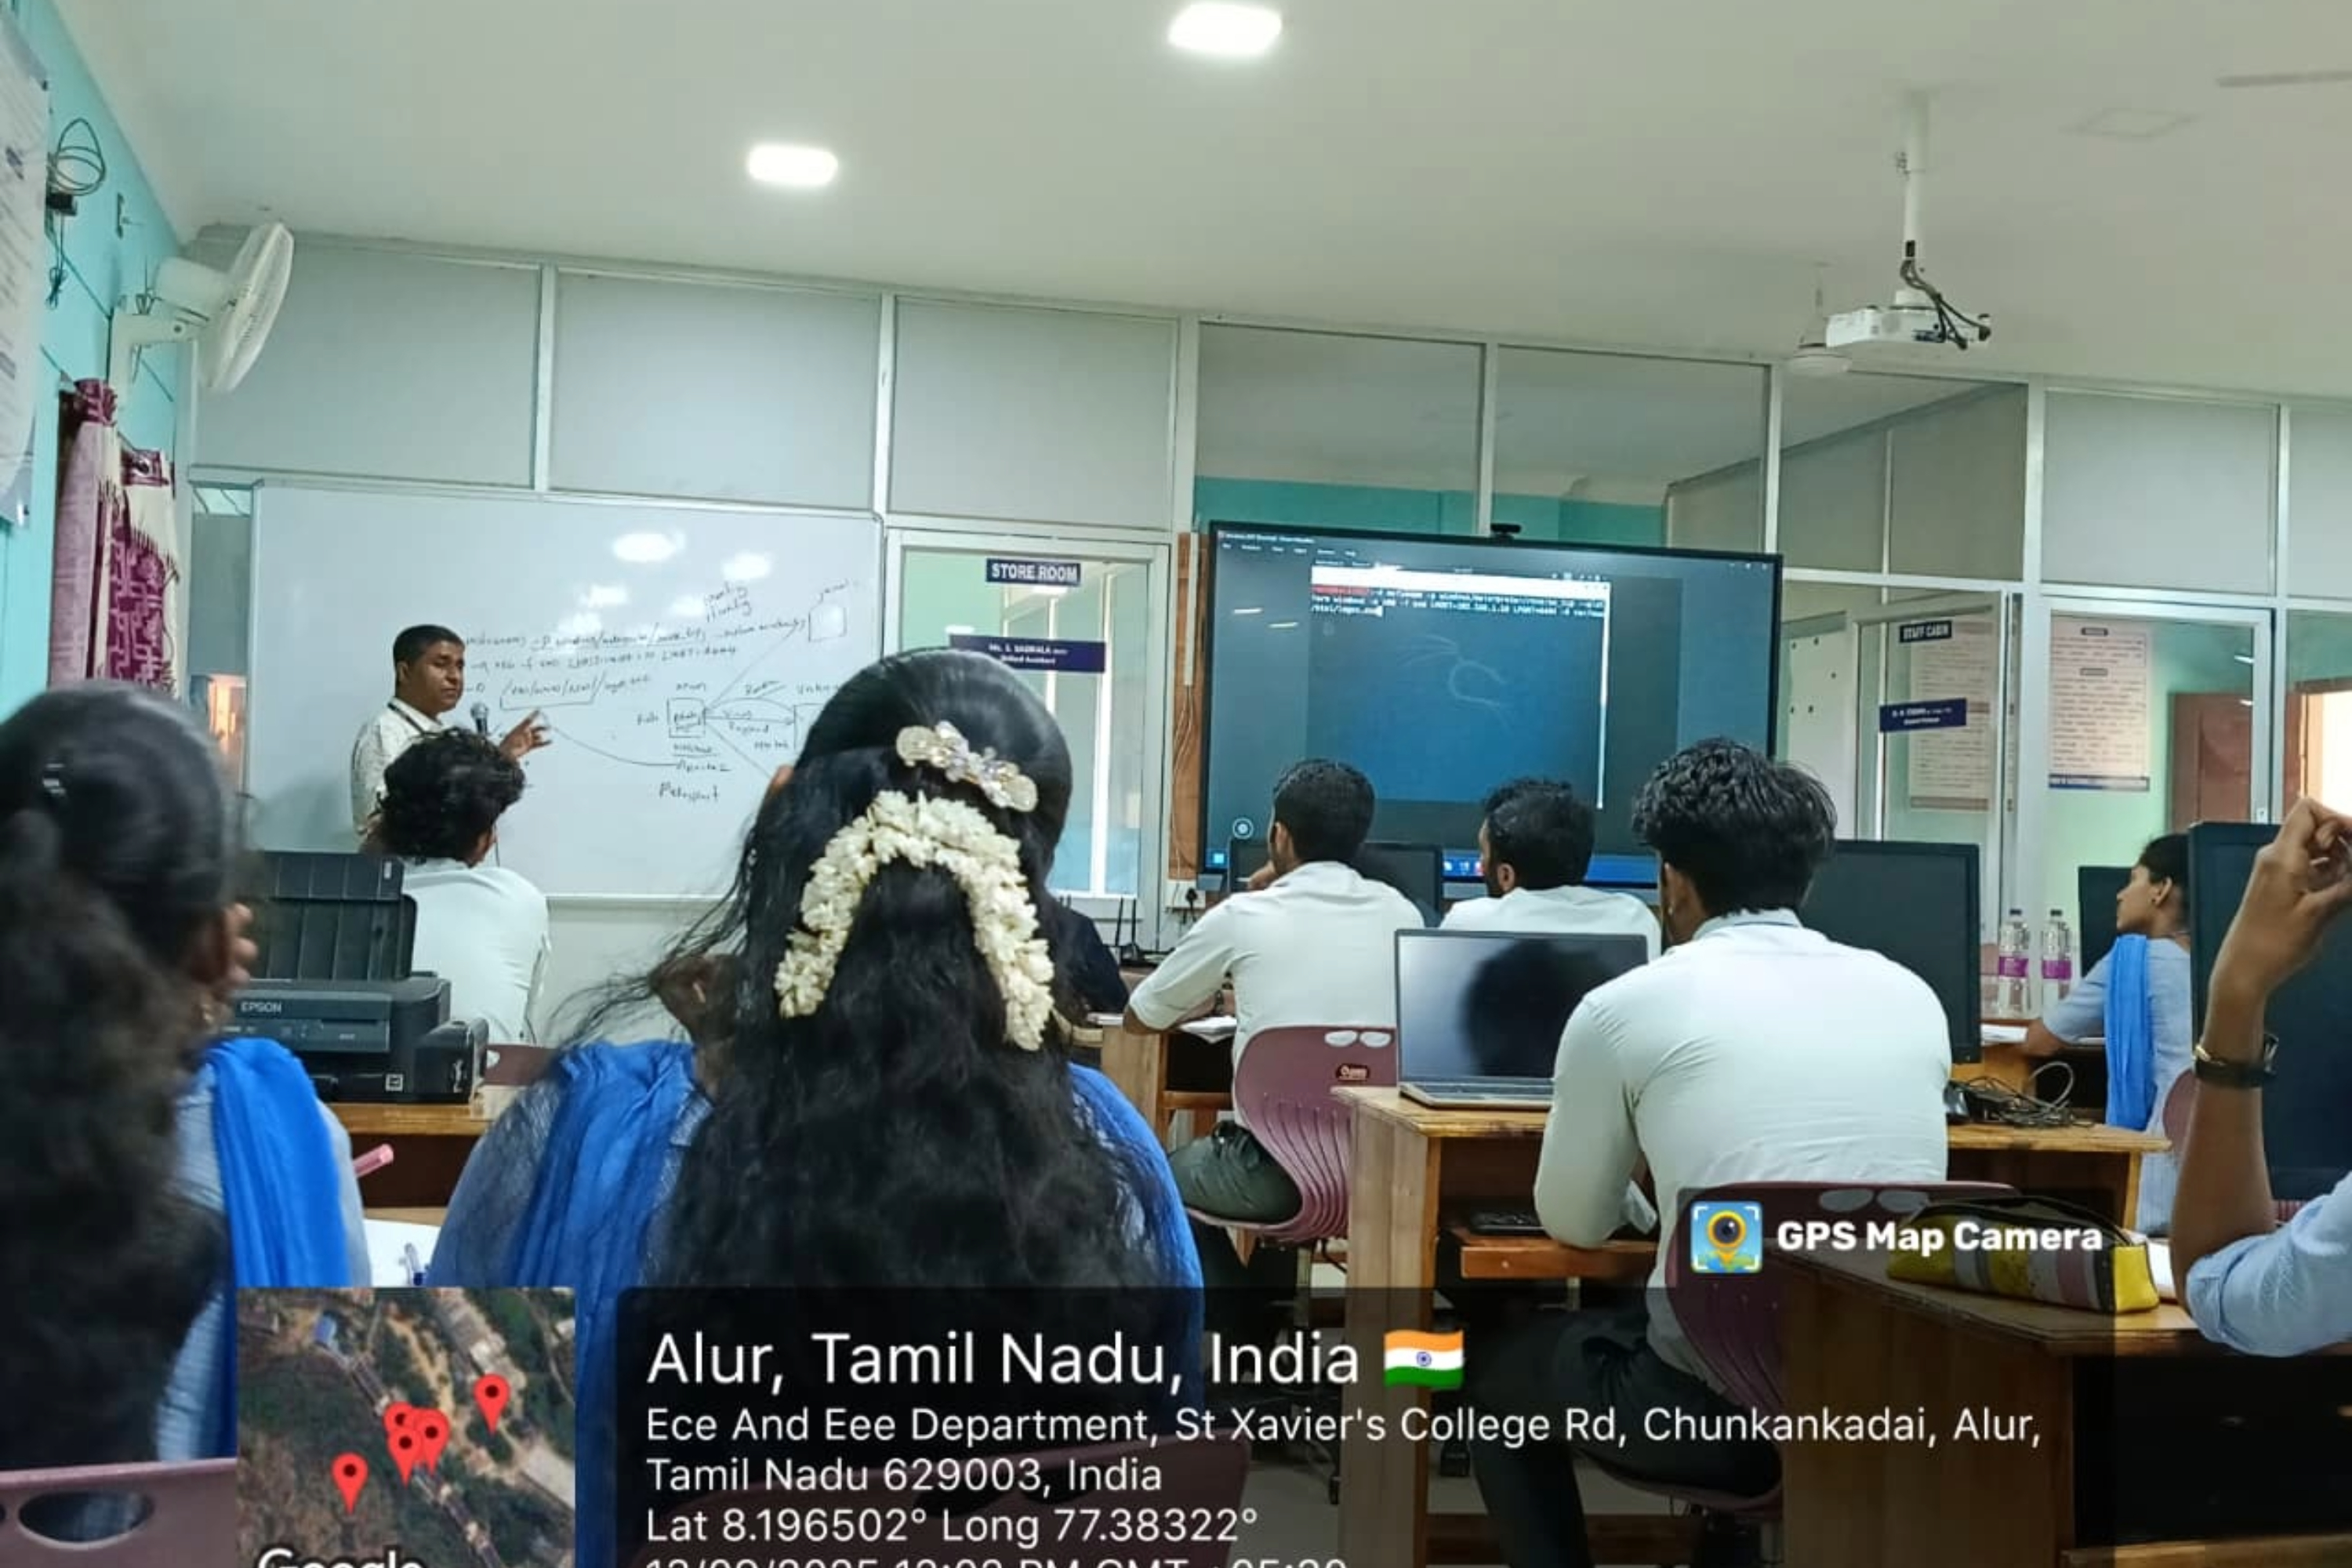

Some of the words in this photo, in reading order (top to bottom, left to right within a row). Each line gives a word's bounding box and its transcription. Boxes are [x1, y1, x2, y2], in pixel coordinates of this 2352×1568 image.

[991, 563, 1036, 579] STORE
[1038, 565, 1078, 583] ROOM
[240, 1001, 282, 1014] EPSON
